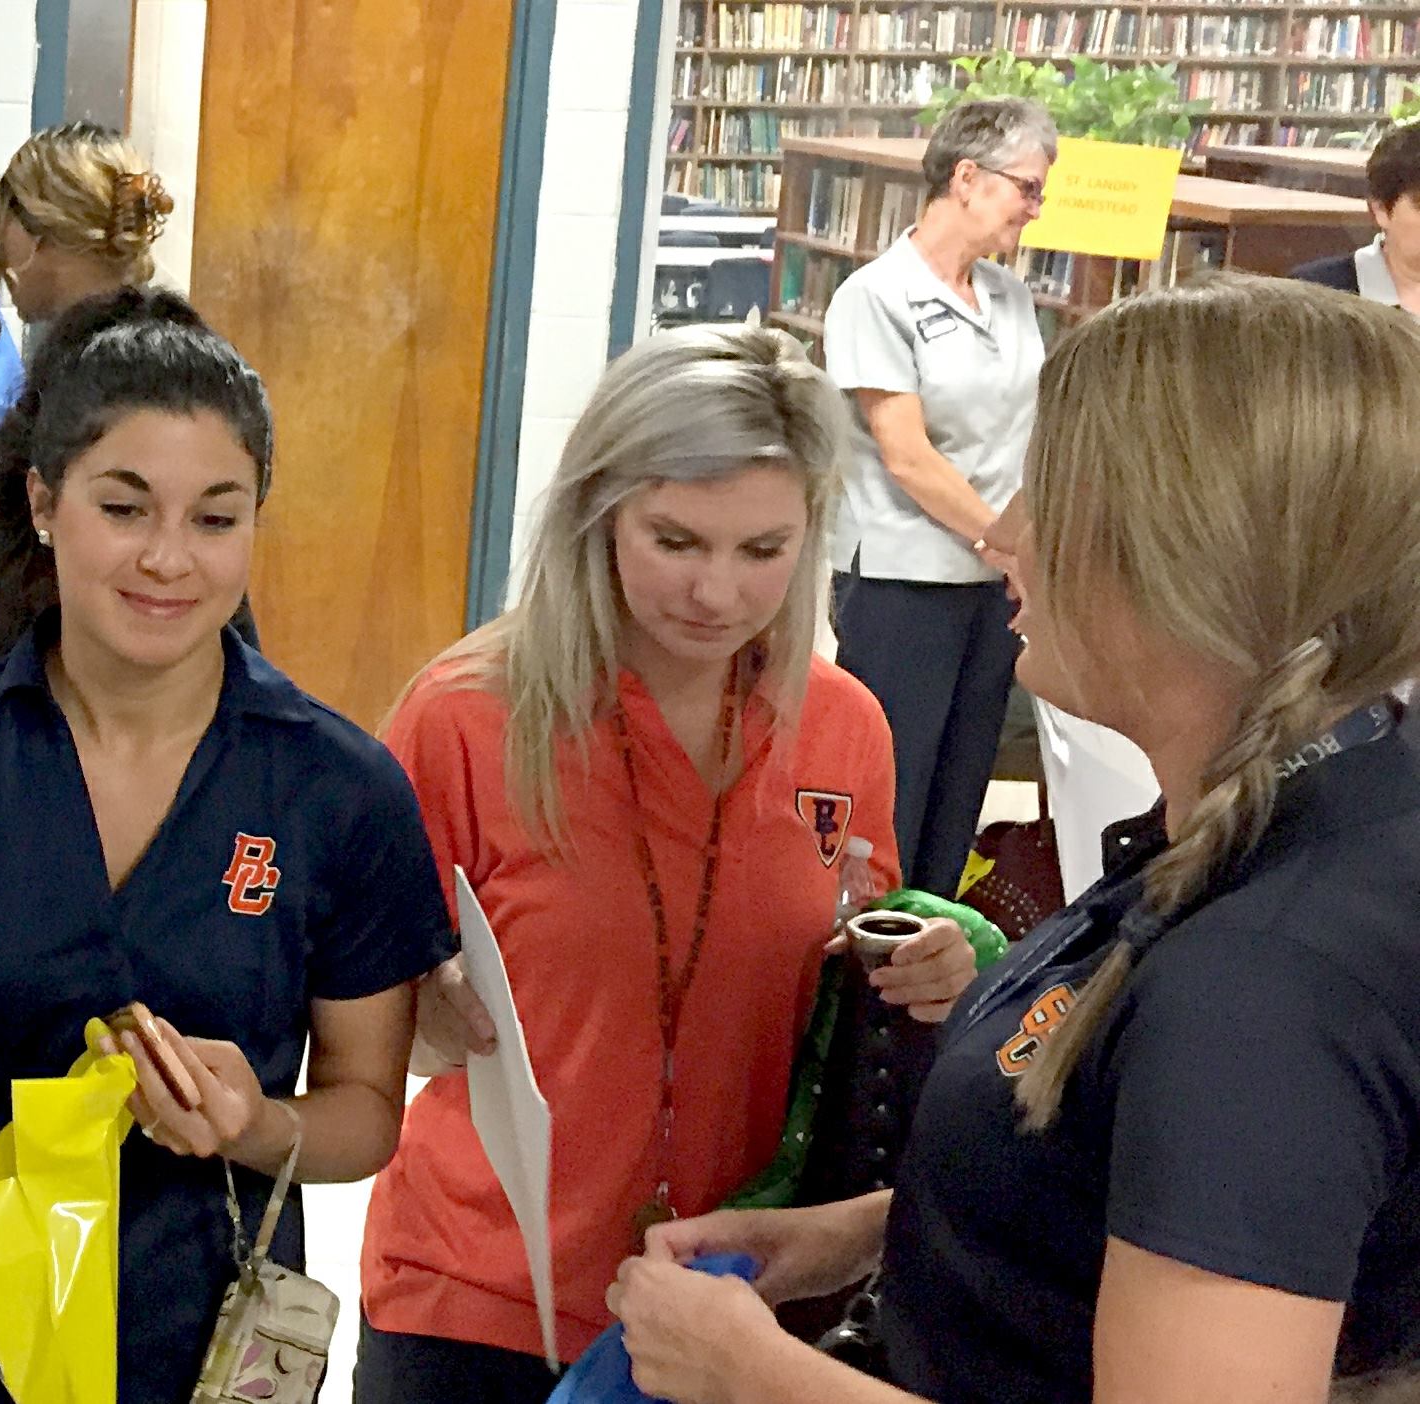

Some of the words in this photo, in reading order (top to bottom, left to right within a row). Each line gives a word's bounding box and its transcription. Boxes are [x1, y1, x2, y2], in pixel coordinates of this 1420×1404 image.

[1087, 177, 1139, 191] LANDRY
[1057, 197, 1139, 215] HOMESTEAD
[221, 831, 282, 917] BC
